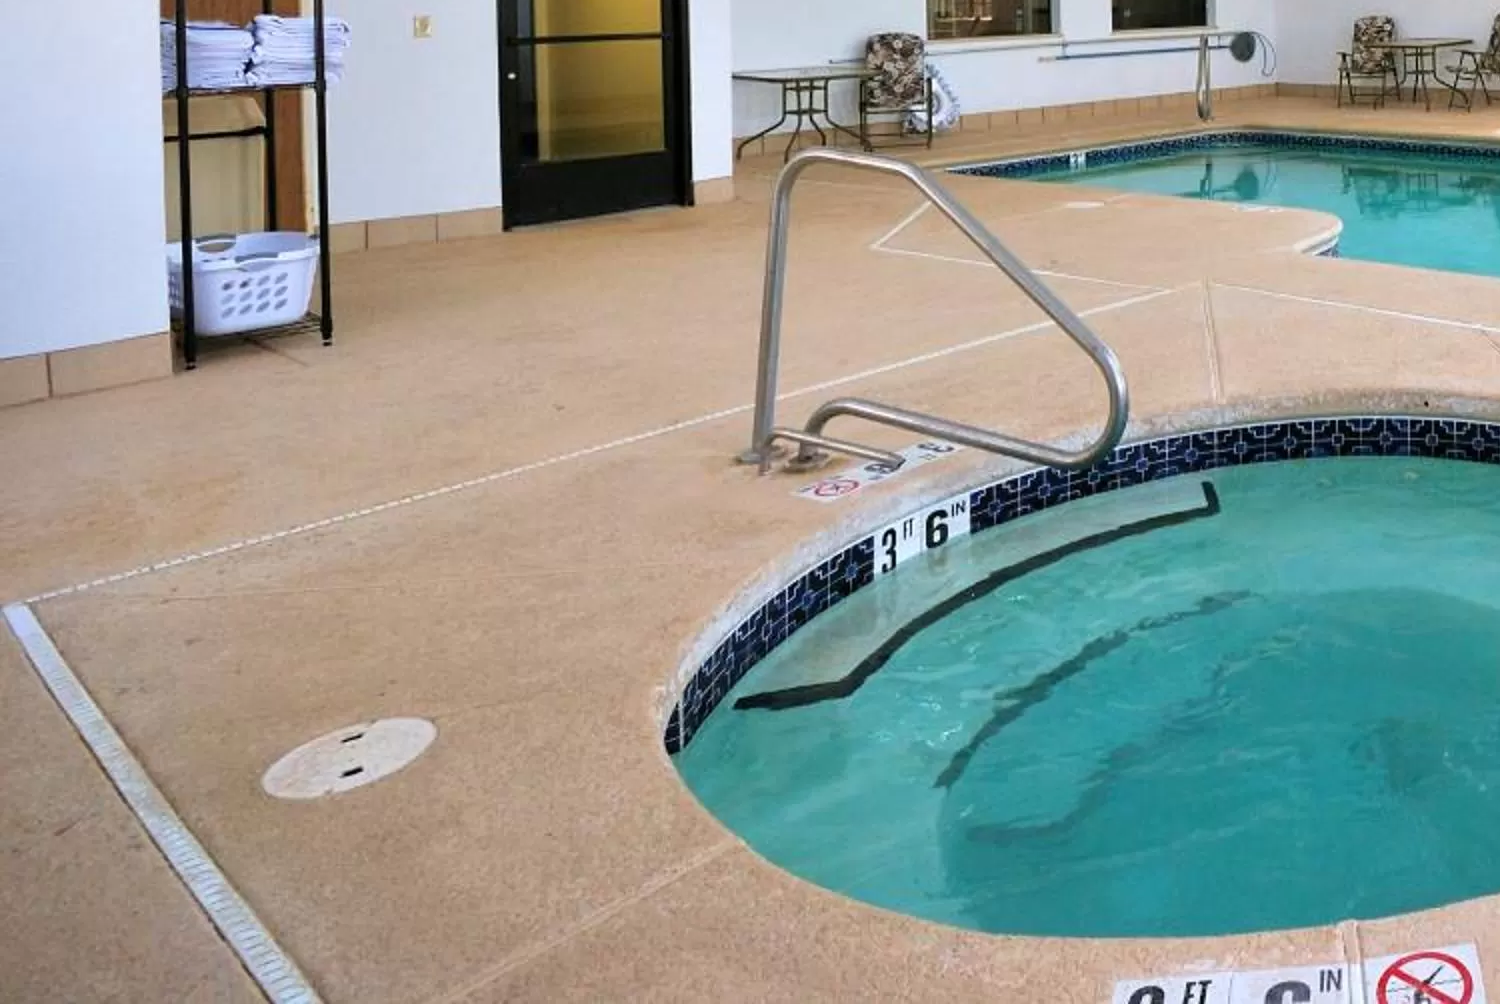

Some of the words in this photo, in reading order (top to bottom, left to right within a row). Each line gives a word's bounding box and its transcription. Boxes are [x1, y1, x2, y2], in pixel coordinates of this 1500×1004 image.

[881, 527, 897, 574] 3
[903, 517, 914, 540] FT
[925, 509, 949, 549] 6
[951, 500, 967, 517] IN
[1182, 979, 1212, 1004] FT
[1319, 968, 1343, 993] IN
